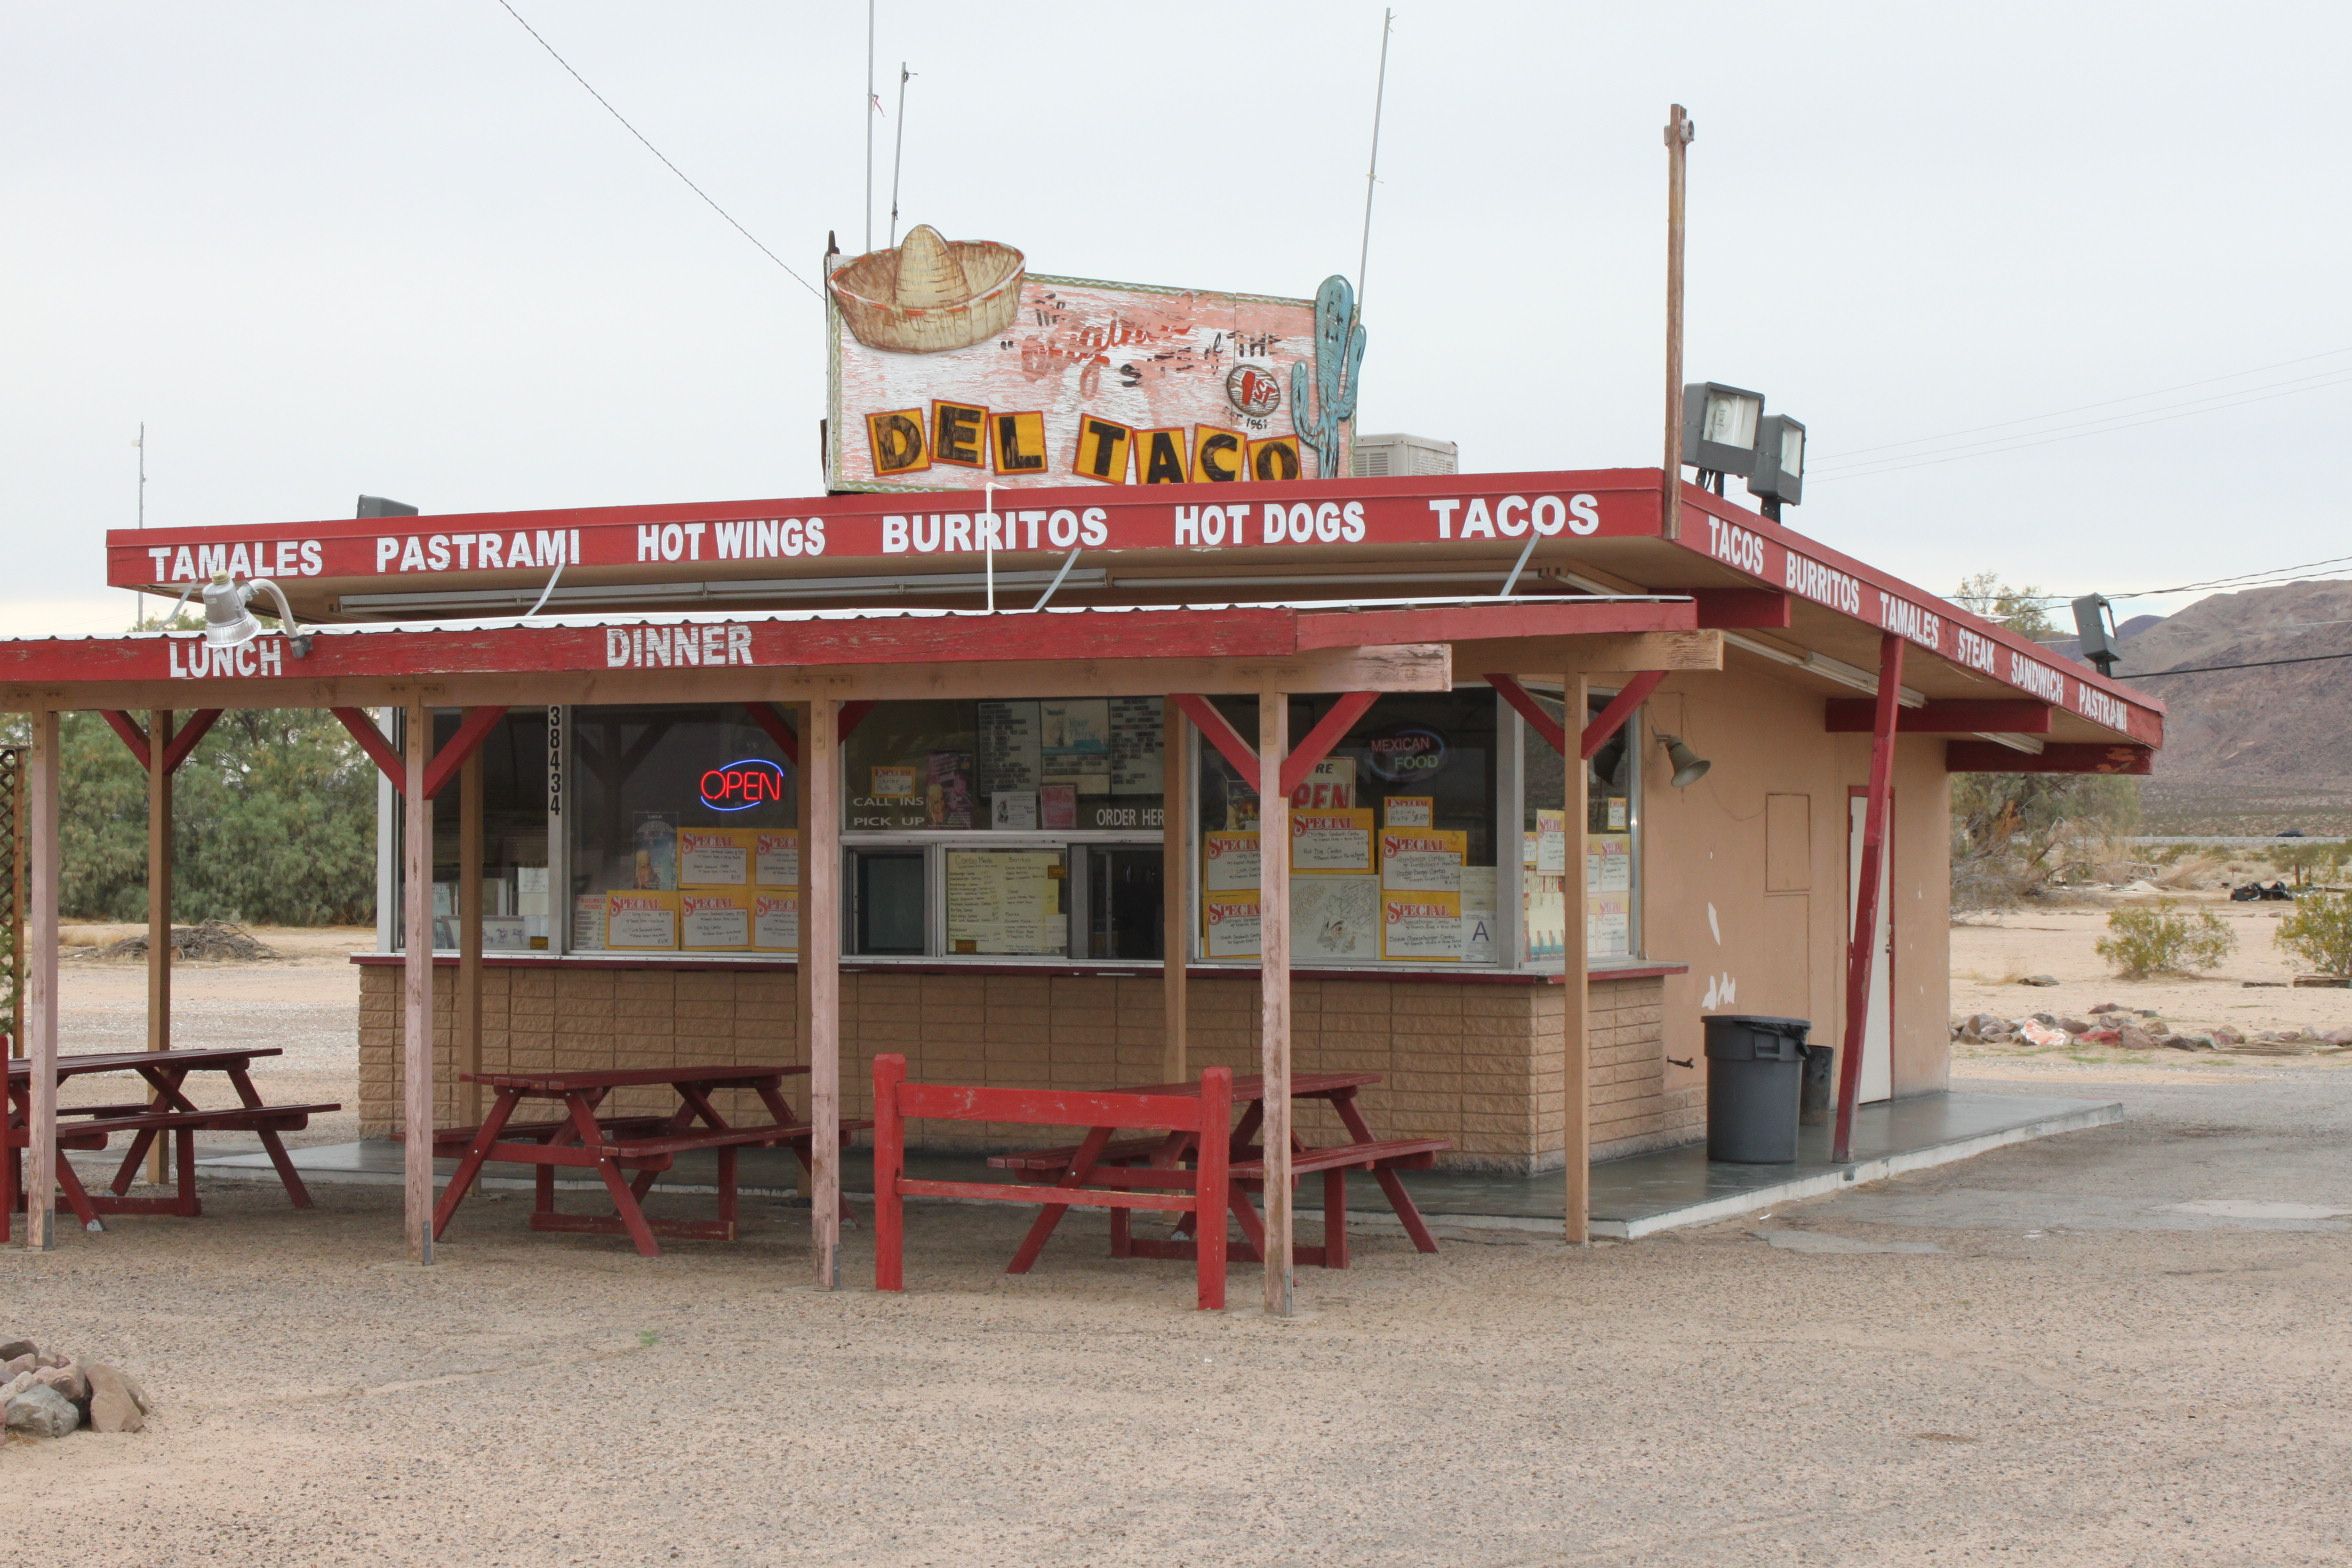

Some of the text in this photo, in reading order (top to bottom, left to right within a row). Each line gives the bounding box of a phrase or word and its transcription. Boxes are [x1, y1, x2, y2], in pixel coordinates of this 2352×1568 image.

[874, 405, 1299, 484] DEL TACO
[1175, 501, 1366, 546] HOT DOGS
[1429, 493, 1600, 540] TACOS
[637, 517, 826, 562] HOT WINGS
[882, 507, 1108, 554] BURRITOS
[376, 529, 580, 573] PASTRAMI
[1708, 515, 1764, 575] TACOS
[148, 540, 323, 582] TAMALES
[1786, 550, 1860, 615] BURRITOS
[1880, 591, 1940, 650] TAMALES
[169, 639, 282, 678] LUNCH
[606, 625, 754, 668] DINNER
[1957, 627, 1995, 675] STEAK
[2010, 651, 2064, 704] SANDWICH
[2078, 683, 2128, 732] PASTRAMI
[1371, 736, 1430, 752] MEXICAN
[1394, 754, 1440, 770] FOOD
[700, 769, 781, 801] OPEN
[1292, 783, 1351, 809] PEN
[853, 797, 924, 807] CALL INS
[853, 817, 925, 826] PICK UP
[1096, 808, 1137, 826] ORDER
[1142, 808, 1165, 826] HER
[1294, 815, 1355, 837] SPECIAL
[683, 832, 736, 855] SPECIAL
[757, 833, 798, 856] SPECI
[1208, 838, 1261, 860] SPECIA
[1383, 835, 1448, 858] SPECIAL
[611, 896, 660, 917] SPECIAL
[683, 896, 737, 917] SPECIAL
[756, 896, 798, 917] SPECI
[1208, 904, 1261, 925] SPECIA
[1386, 902, 1450, 924] SPECIAL
[1472, 920, 1490, 941] A
